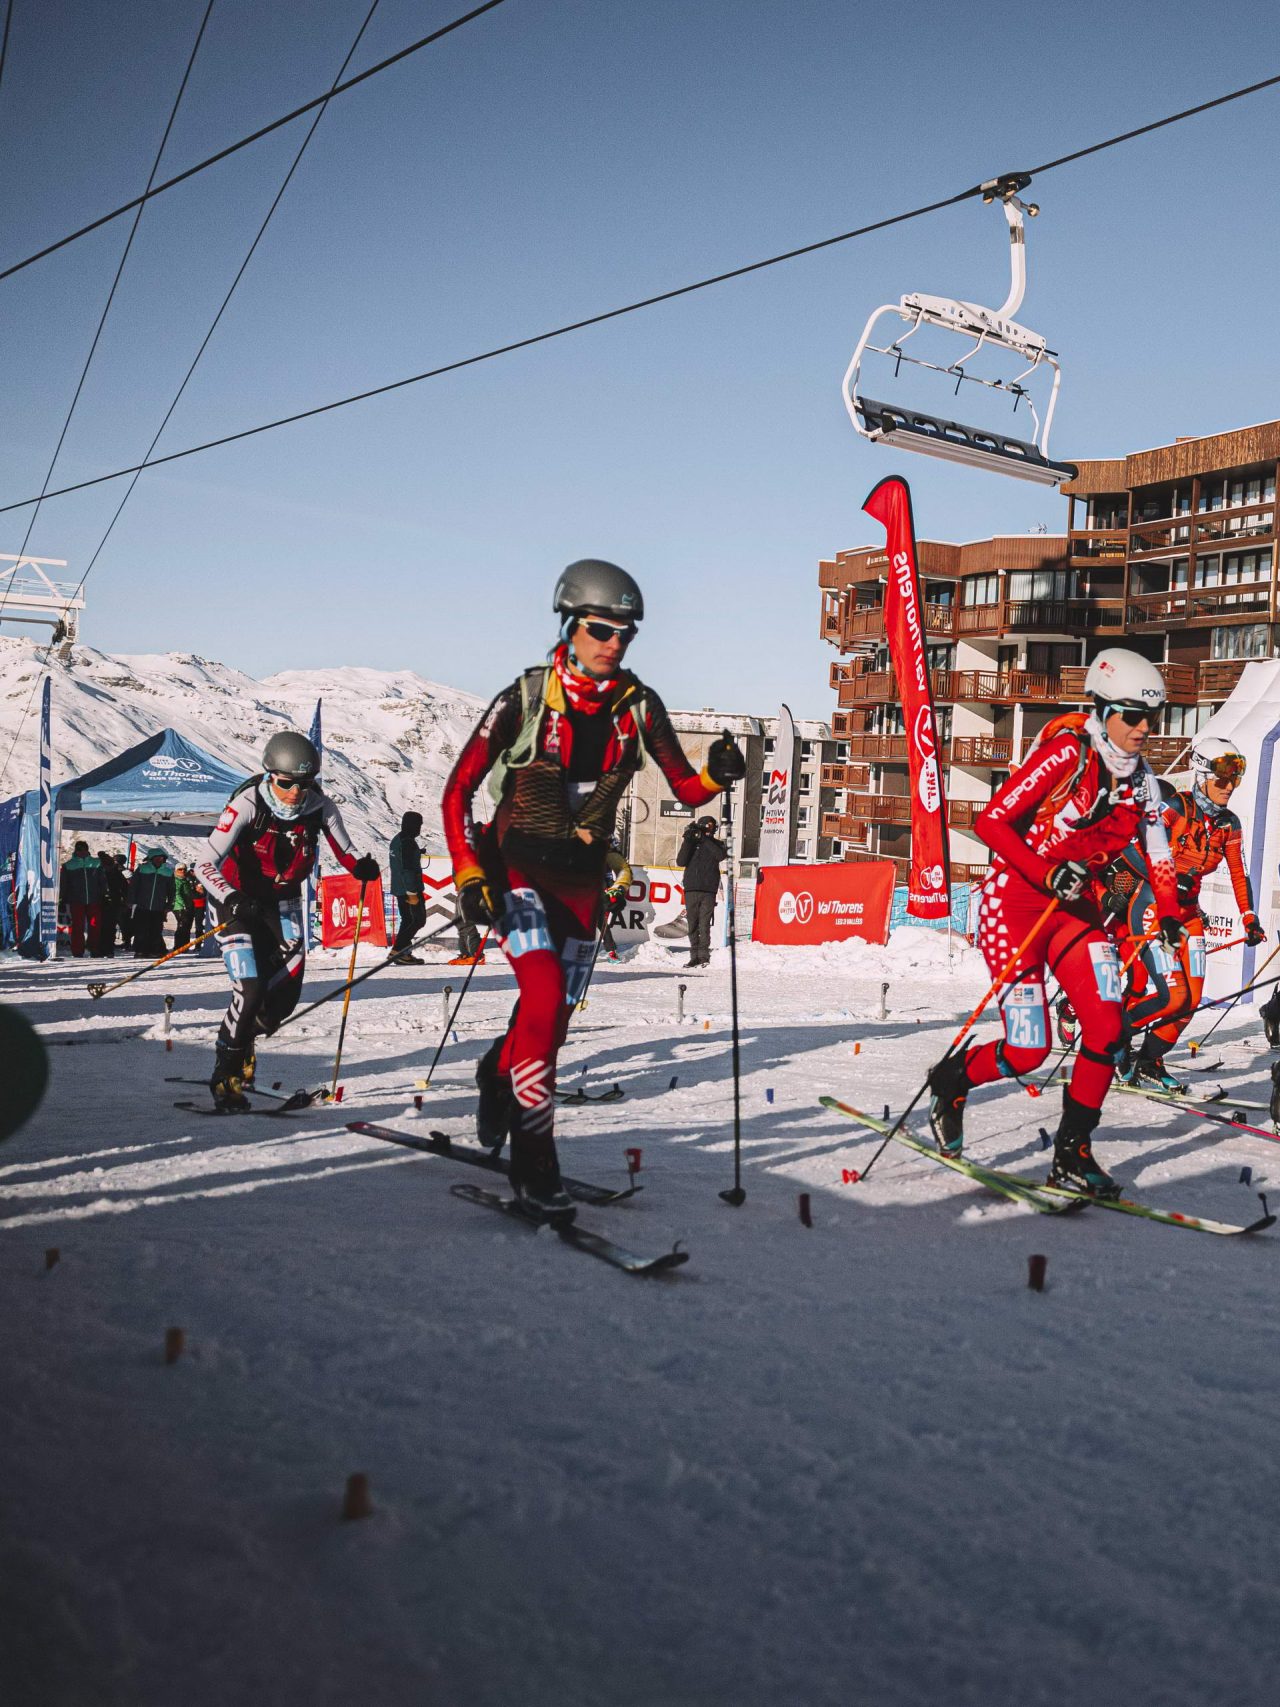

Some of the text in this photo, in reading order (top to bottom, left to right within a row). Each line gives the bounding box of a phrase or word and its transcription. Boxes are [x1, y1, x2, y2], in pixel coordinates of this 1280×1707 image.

[142, 770, 214, 781] Val Thorens
[1003, 744, 1078, 810] SPORTIVA
[818, 901, 863, 914] Val Thorens
[1010, 1007, 1039, 1046] 25.1
